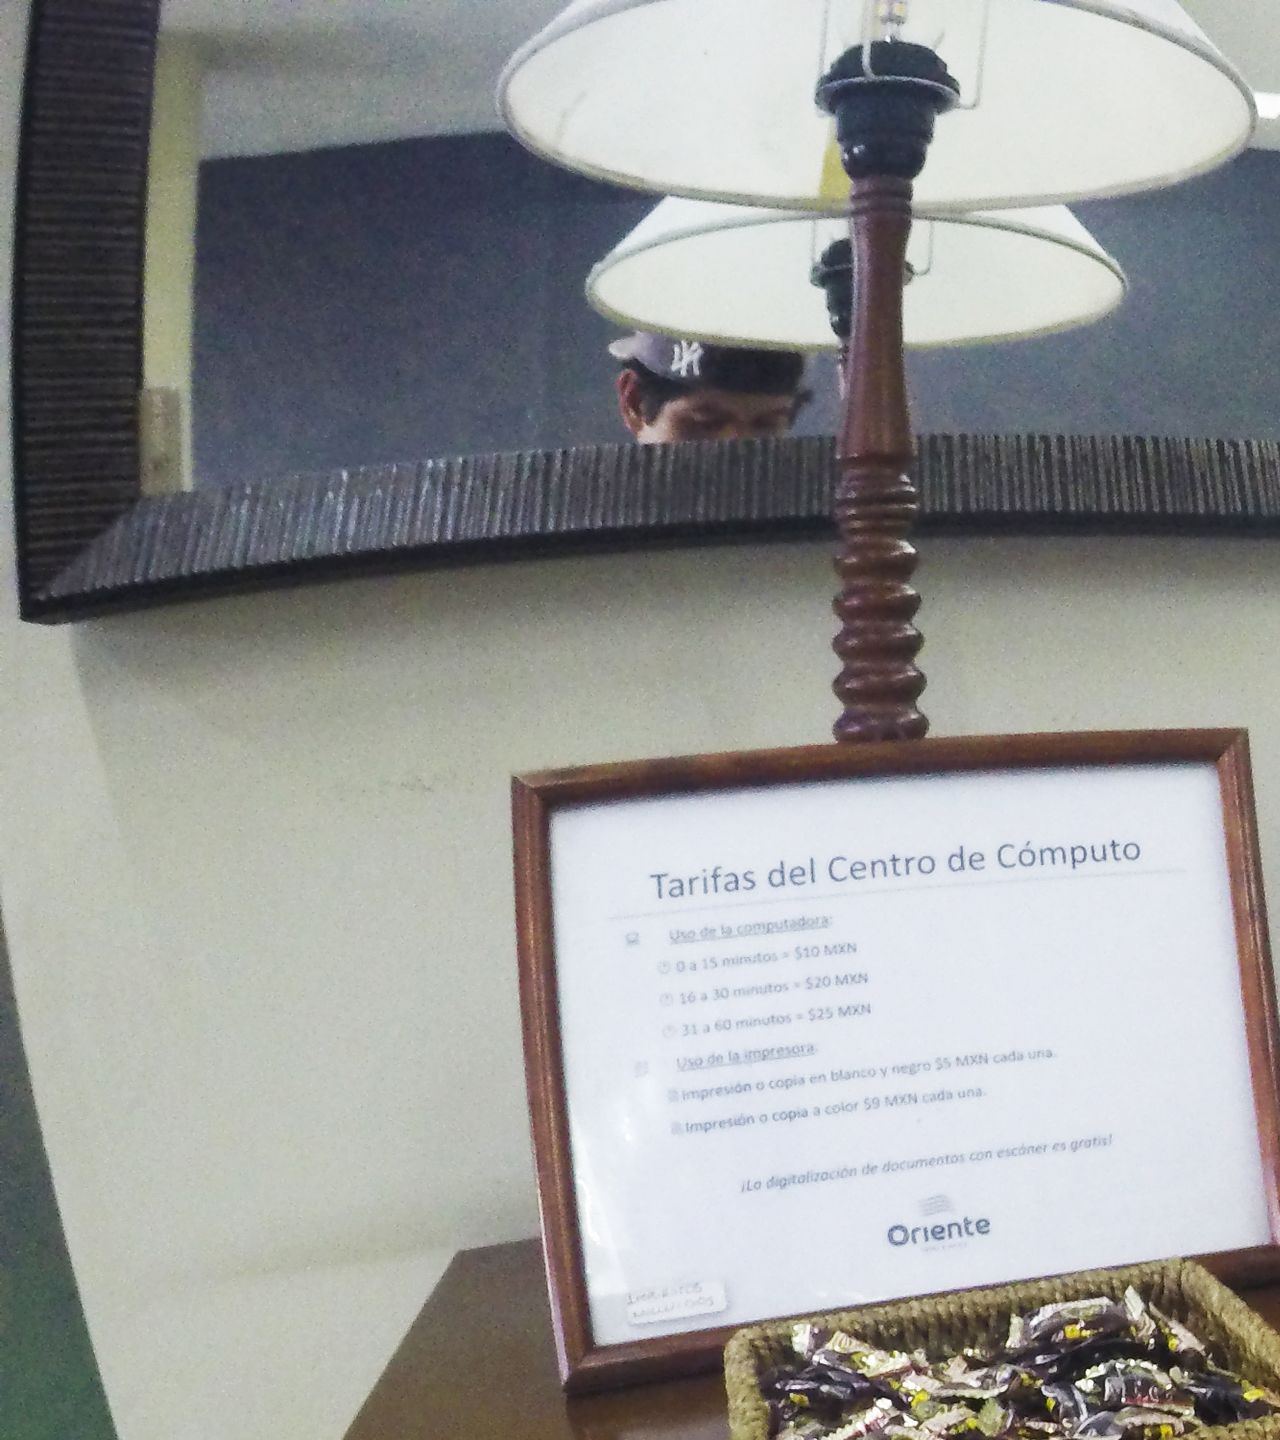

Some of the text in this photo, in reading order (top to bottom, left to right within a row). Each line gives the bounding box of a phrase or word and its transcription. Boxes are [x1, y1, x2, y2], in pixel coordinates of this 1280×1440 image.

[650, 840, 1142, 900] Tarifas del Centro de Cómputo
[669, 929, 696, 944] Uso
[699, 926, 717, 941] de
[720, 923, 733, 938] la
[722, 951, 779, 968] minutos
[823, 942, 858, 956] MXN
[733, 981, 789, 998] minutos
[835, 972, 869, 986] MXN
[735, 1012, 792, 1030] minutos
[837, 1003, 871, 1017] MXN
[768, 1074, 805, 1091] copia
[809, 1071, 827, 1084] en
[830, 1067, 876, 1083] blanco
[880, 1067, 888, 1078] y
[892, 1061, 931, 1077] negro
[955, 1053, 989, 1067] MXN
[993, 1050, 1024, 1064] cada
[686, 1112, 755, 1134] Impresión
[759, 1112, 768, 1123] o
[772, 1105, 808, 1124] copia
[812, 1106, 821, 1116] a
[825, 1100, 859, 1115] color
[885, 1093, 918, 1108] MXN
[922, 1089, 953, 1104] cada
[766, 1165, 857, 1190] digitalización
[862, 1162, 878, 1176] de
[882, 1151, 965, 1173] documentos
[969, 1150, 993, 1162] con
[1052, 1141, 1066, 1152] es
[1070, 1133, 1113, 1153] gratis!
[887, 1216, 991, 1247] Oriente
